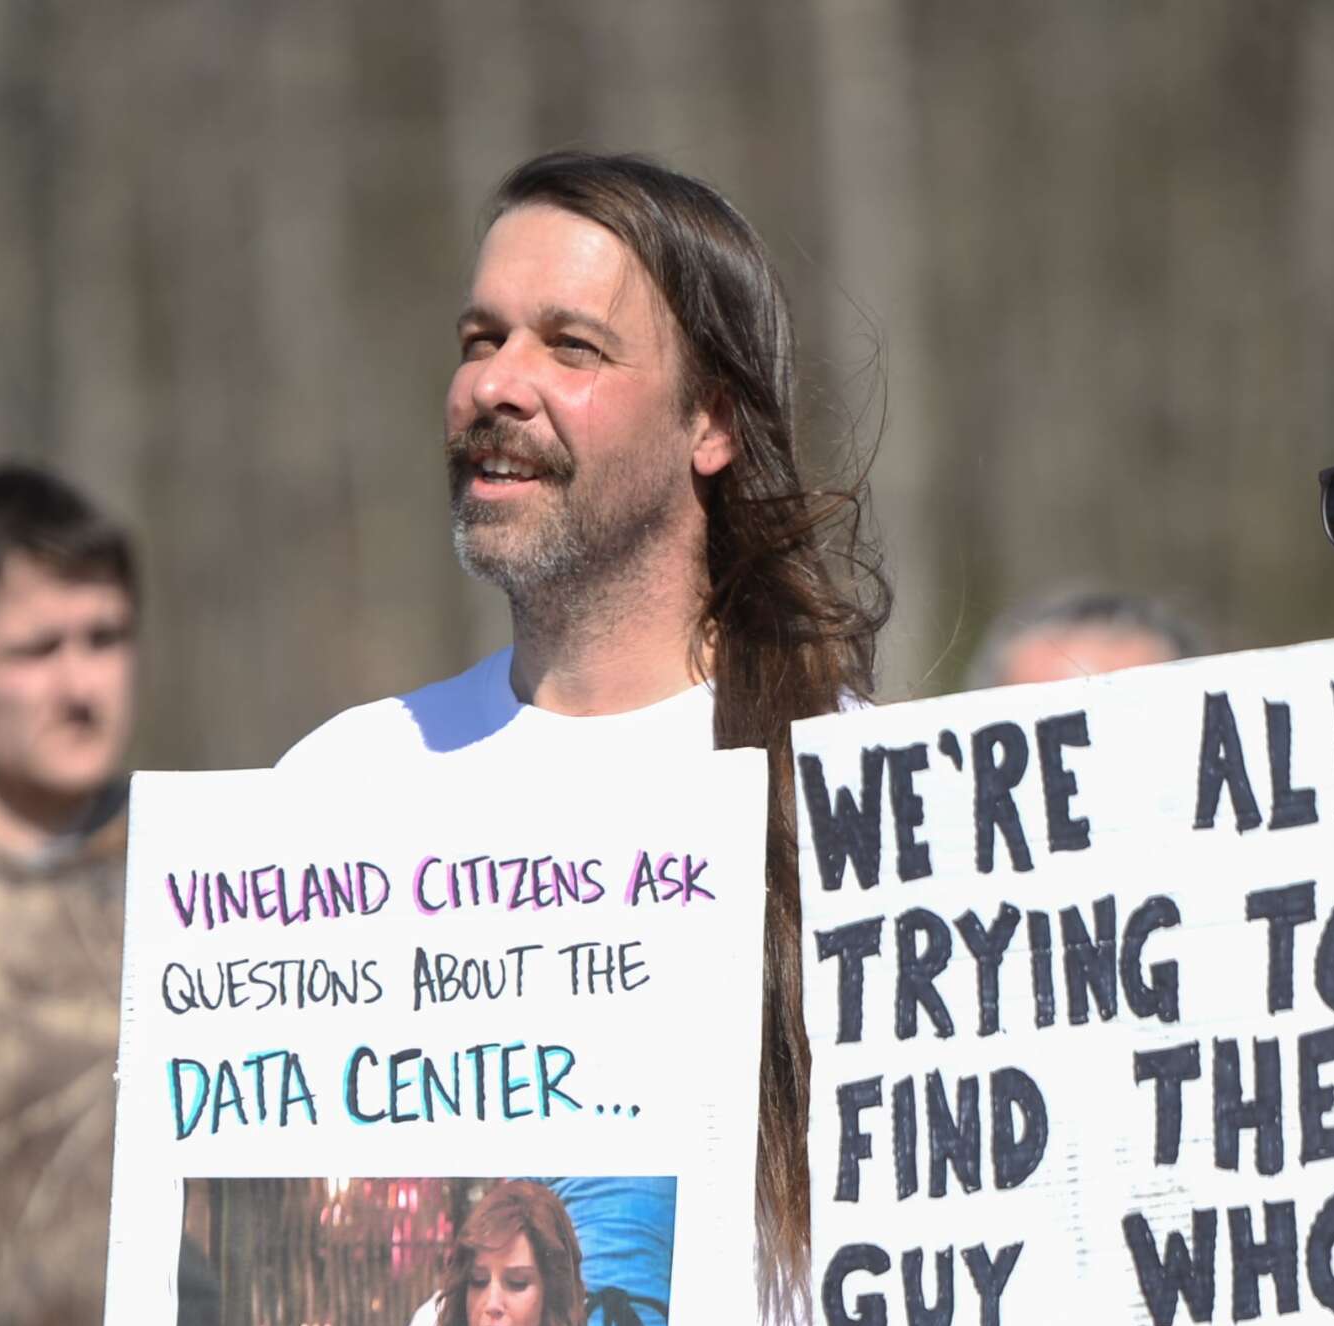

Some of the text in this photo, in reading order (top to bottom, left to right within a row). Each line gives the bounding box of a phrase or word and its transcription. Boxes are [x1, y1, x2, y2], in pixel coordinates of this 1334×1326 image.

[798, 709, 1091, 890] WE'RE
[166, 851, 716, 930] VINELAND CITIZENS ASK
[162, 941, 650, 1015] QUESTIONS ABOUT THE
[815, 893, 1182, 1044] TRYING
[166, 1039, 641, 1141] DATA CENTER...
[834, 1067, 1049, 1203] FIND
